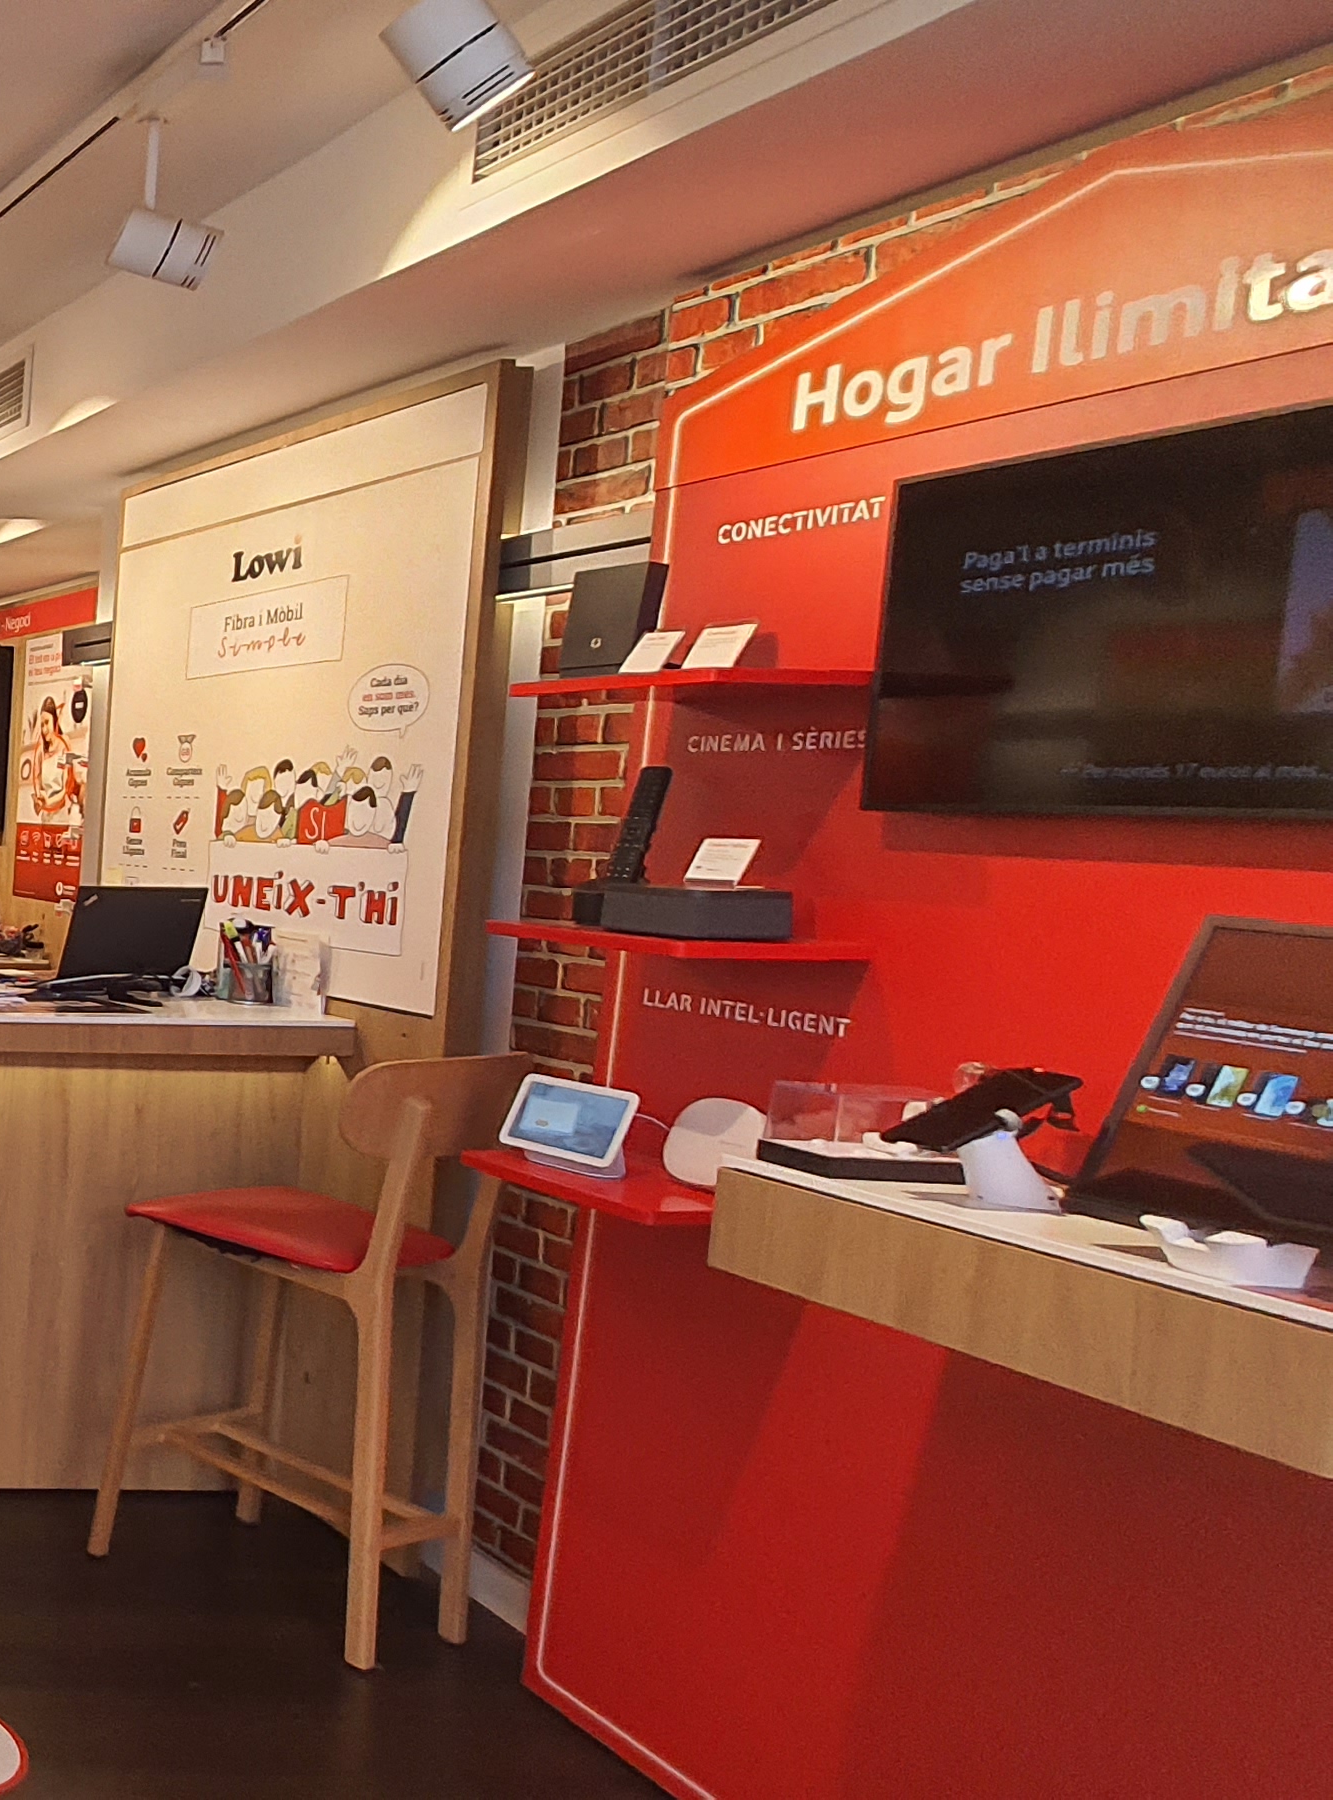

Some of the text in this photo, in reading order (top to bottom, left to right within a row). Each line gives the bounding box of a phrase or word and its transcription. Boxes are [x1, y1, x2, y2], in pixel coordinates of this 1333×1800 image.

[789, 332, 1014, 433] Hogar
[716, 495, 887, 545] CONECTIVITAT
[230, 534, 303, 583] Lowi
[1034, 547, 1048, 562] a
[959, 555, 1155, 594] sense pagar més
[5, 612, 32, 634] Negoci
[223, 602, 304, 634] Fibra i Mòbil
[380, 703, 396, 718] per
[687, 726, 867, 753] CINEMA I SÈRIES
[642, 987, 852, 1039] LLAR INTEL·LIGENT
